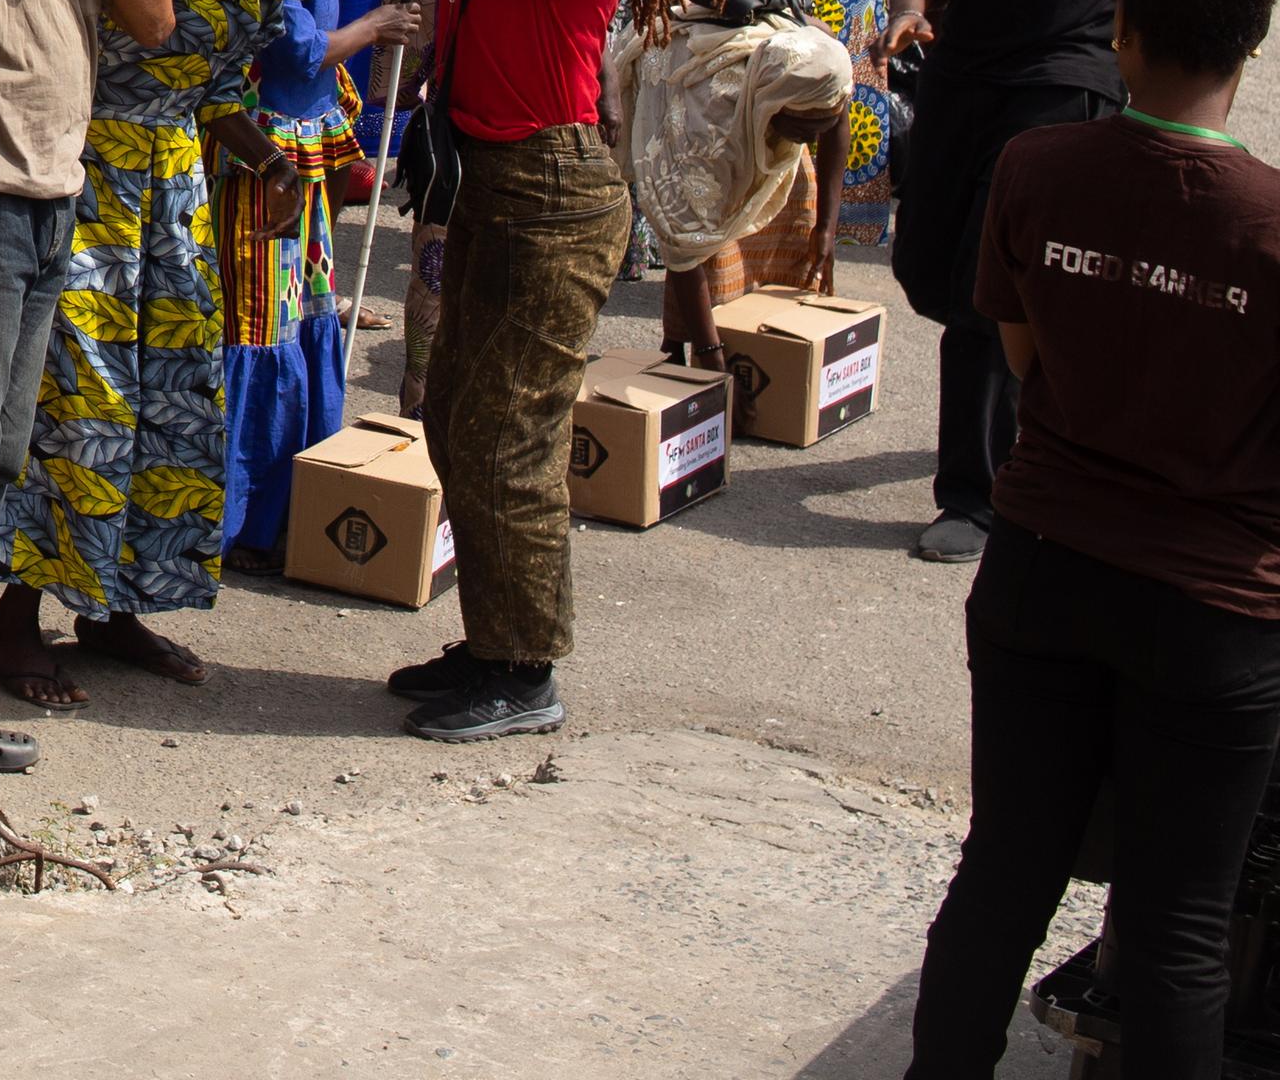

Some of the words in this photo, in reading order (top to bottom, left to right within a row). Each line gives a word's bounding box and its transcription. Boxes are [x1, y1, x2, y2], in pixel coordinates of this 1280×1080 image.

[1043, 240, 1123, 282] FOOD
[827, 370, 842, 388] HFM
[843, 360, 860, 381] SANTA
[861, 355, 872, 373] BOX
[668, 446, 686, 464] HFM
[686, 431, 706, 455] SANTA
[706, 424, 720, 444] BOX
